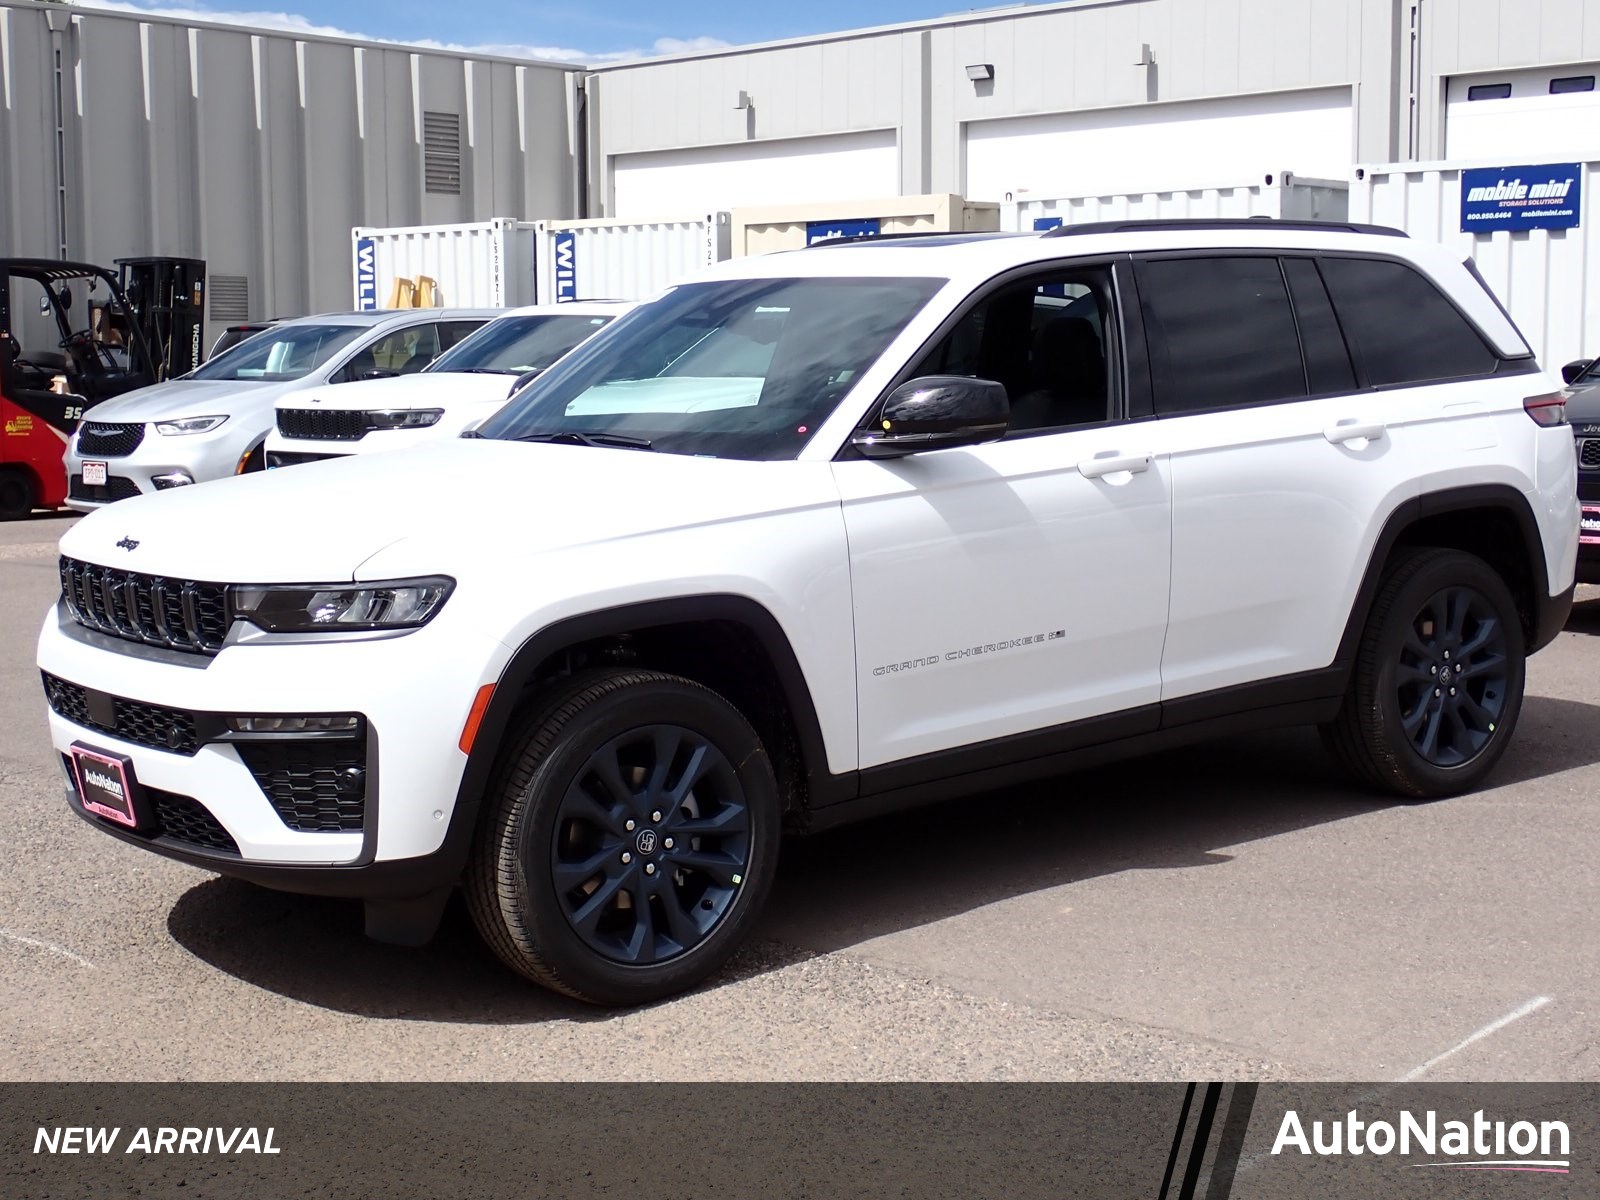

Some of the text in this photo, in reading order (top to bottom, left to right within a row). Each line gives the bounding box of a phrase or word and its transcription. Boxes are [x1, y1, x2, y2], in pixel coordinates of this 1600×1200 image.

[1467, 179, 1571, 202] mobile mini
[1498, 198, 1564, 208] STORAGE SOLUTIONS
[1467, 209, 1573, 221] 800.950.6464 mobilemini.com
[64, 406, 82, 420] 35
[116, 535, 140, 552] Jeep
[872, 655, 940, 677] GRAND
[944, 633, 1045, 661] CHEROKEE
